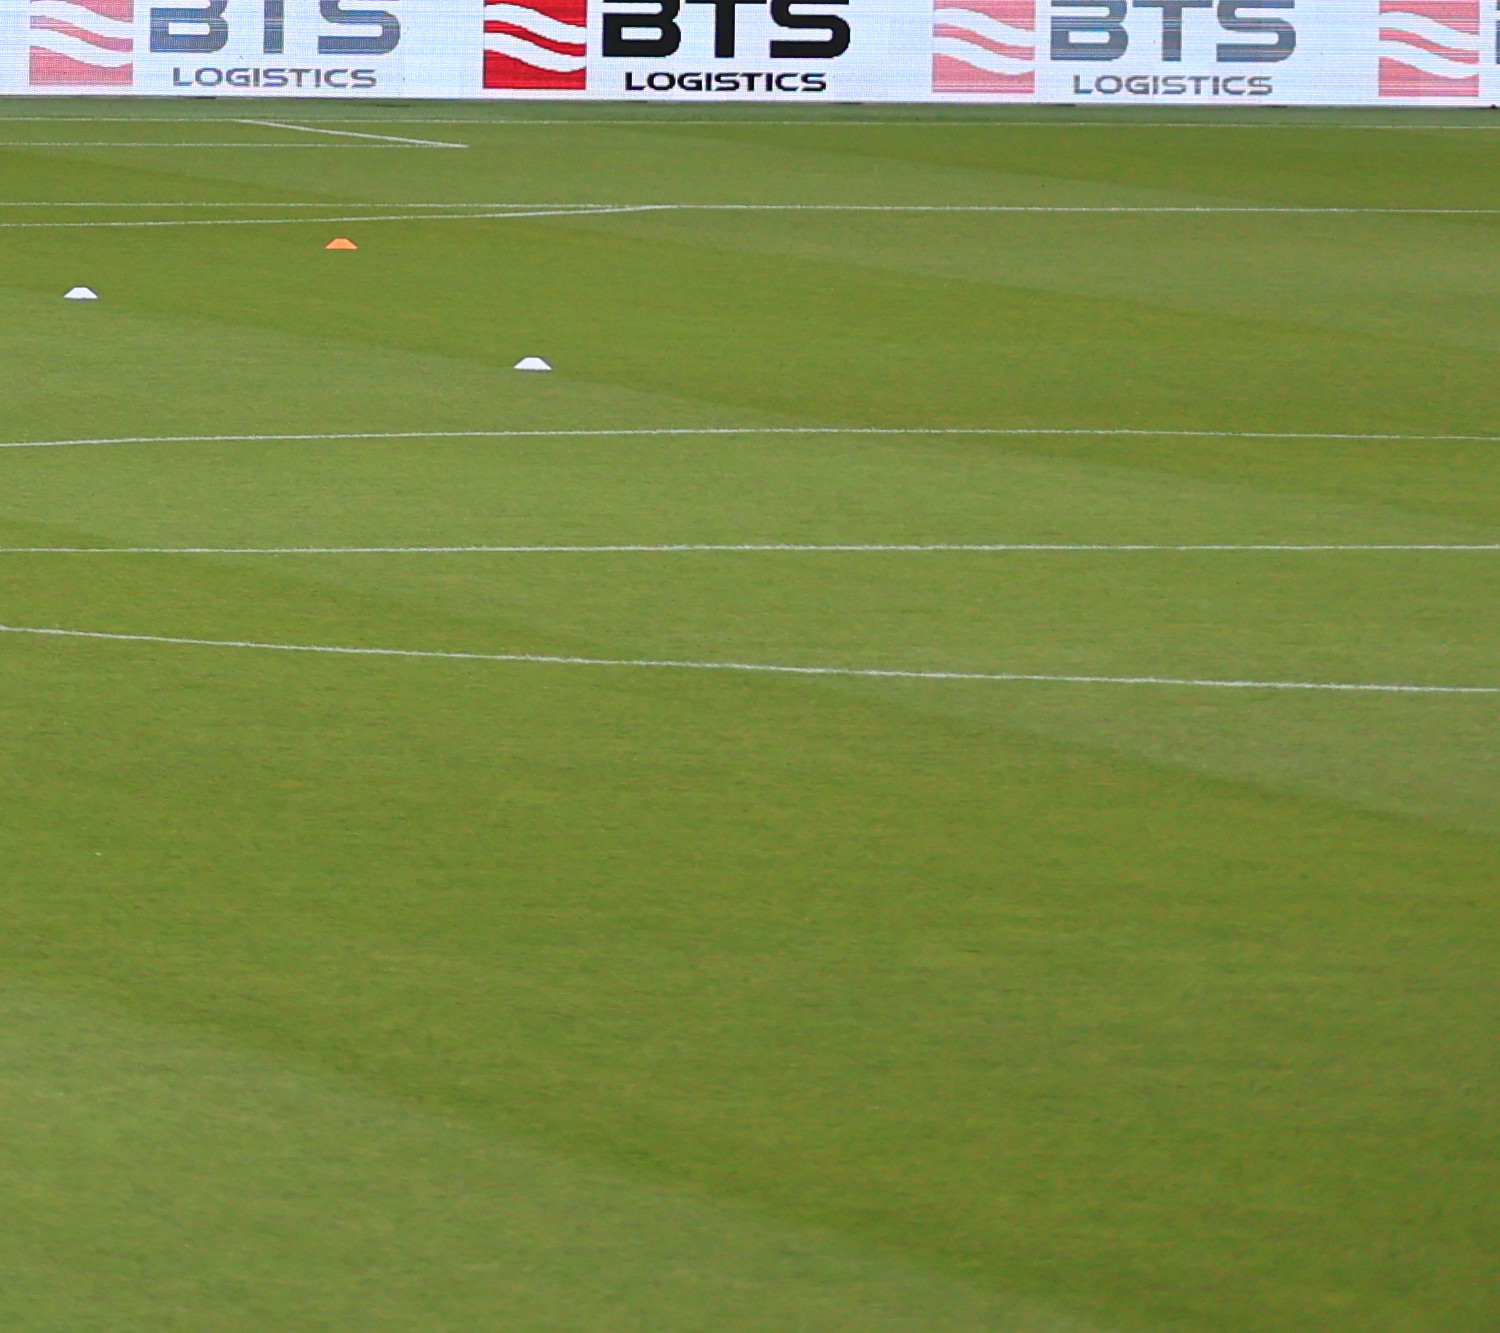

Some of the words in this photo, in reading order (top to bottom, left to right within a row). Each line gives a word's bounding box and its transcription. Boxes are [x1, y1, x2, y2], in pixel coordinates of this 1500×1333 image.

[172, 67, 377, 88] LOGISTICS
[624, 72, 827, 92] LOGISTICS
[1072, 75, 1273, 96] LOGISTICS
